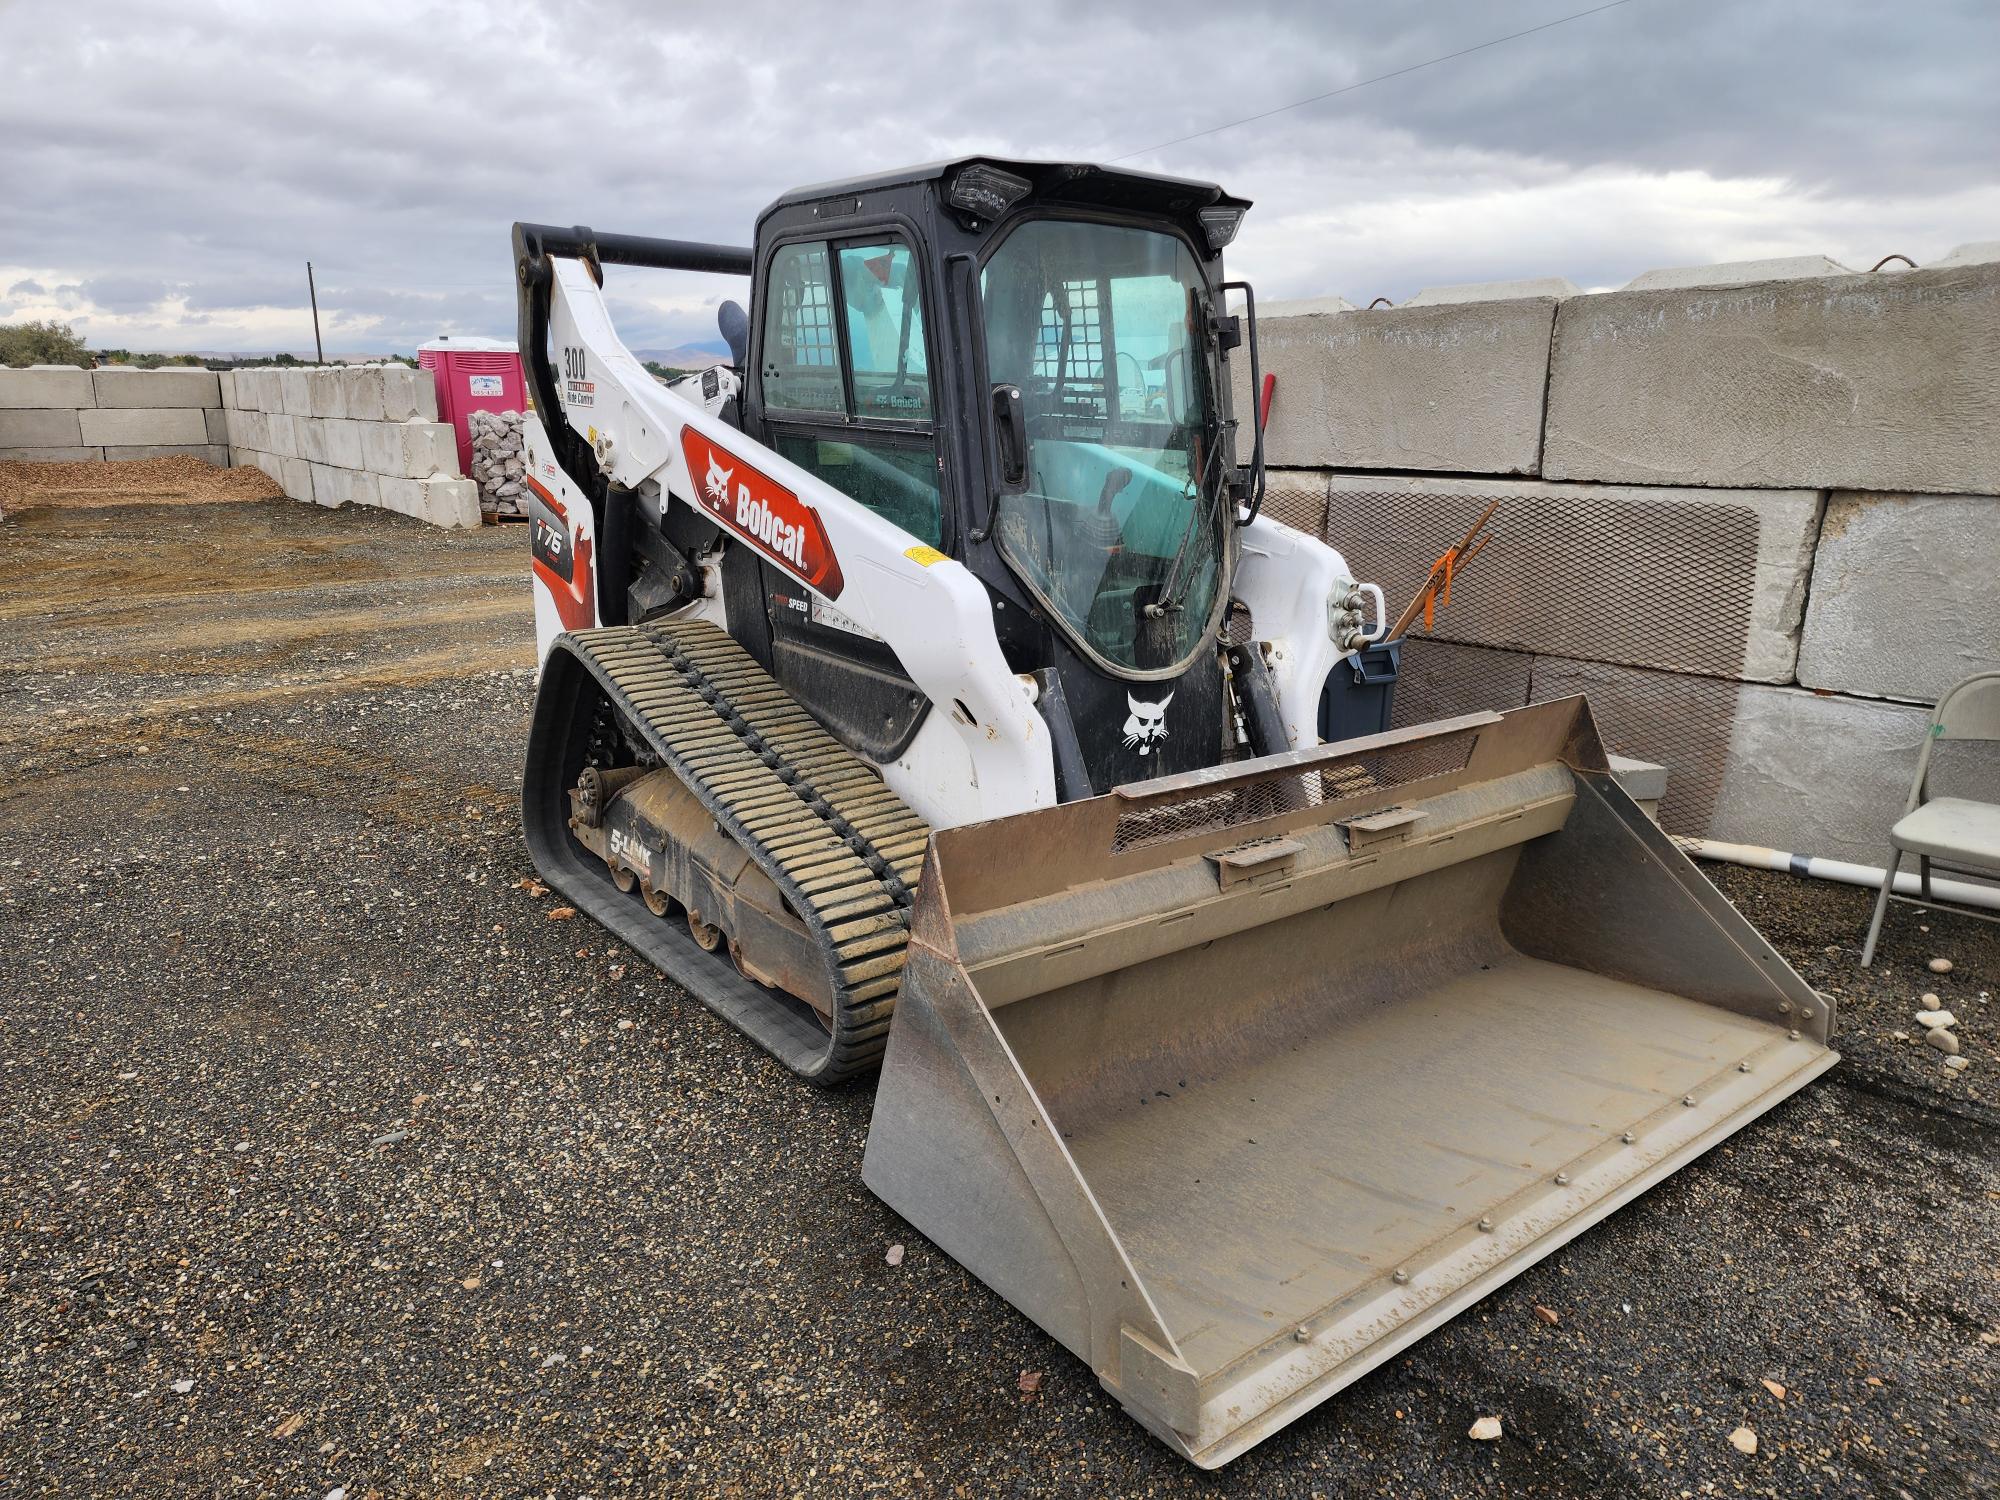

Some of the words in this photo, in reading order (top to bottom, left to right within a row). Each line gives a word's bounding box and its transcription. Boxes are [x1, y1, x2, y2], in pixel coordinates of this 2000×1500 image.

[565, 347, 586, 380] 300
[537, 518, 562, 555] T76
[736, 483, 805, 568] Bobcat
[788, 598, 808, 613] SPEED
[610, 828, 651, 867] 5-LINK
